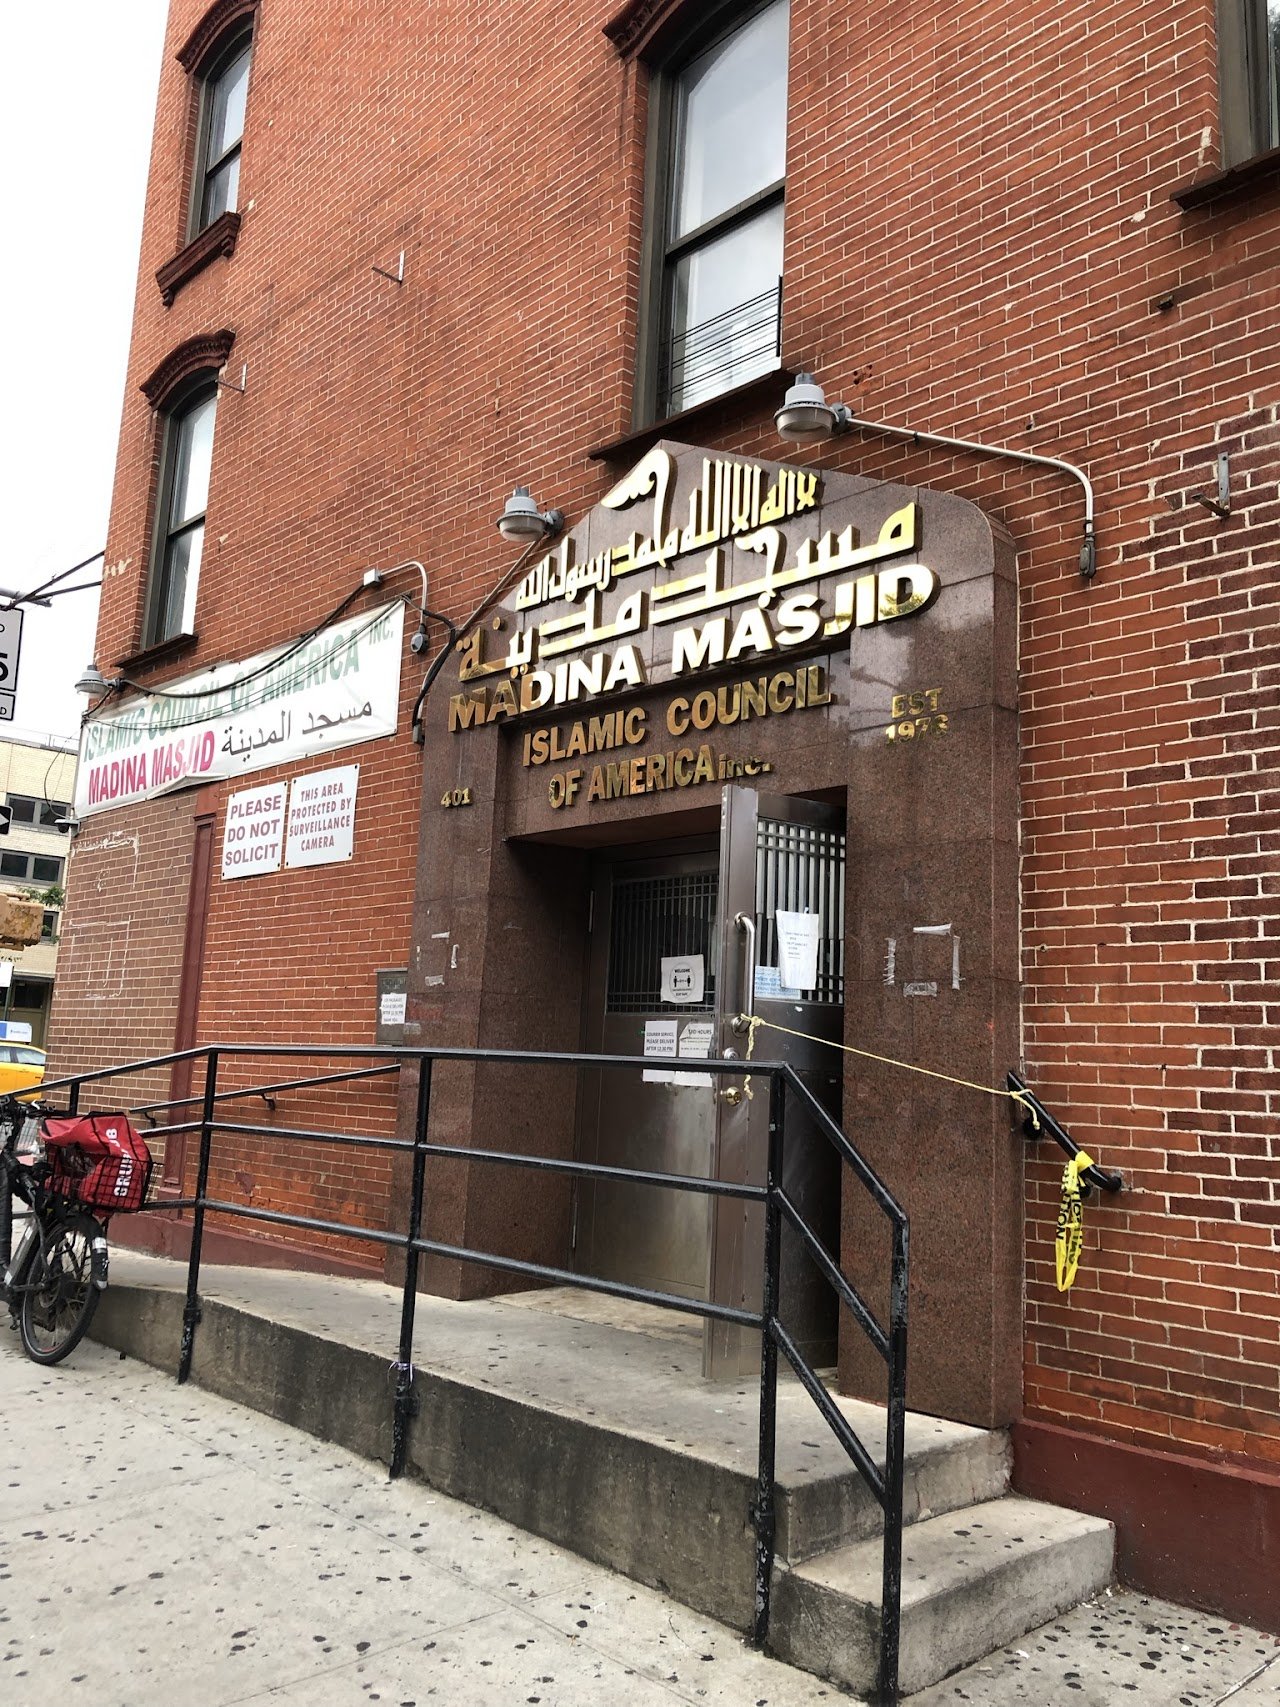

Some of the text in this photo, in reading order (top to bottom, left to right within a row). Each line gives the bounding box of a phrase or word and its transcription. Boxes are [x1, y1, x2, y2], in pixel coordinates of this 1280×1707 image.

[448, 562, 938, 734] MADINA MASJID
[83, 708, 146, 763] ISLAMIC
[148, 681, 223, 738] COUNCIL
[231, 667, 257, 714] OF
[260, 630, 360, 705] AMERICA
[892, 687, 943, 718] EST
[522, 665, 833, 768] ISLAMIC COUNCIL
[221, 700, 373, 763] مسجد المدينة
[88, 730, 216, 806] MADINA MASJID
[548, 769, 582, 809] OF
[587, 744, 715, 802] AMERICA
[301, 782, 344, 802] THIS AREA
[441, 786, 472, 808] 401
[230, 795, 282, 819] PLEASE
[291, 797, 352, 820] PROTECTED BY
[227, 819, 280, 843] DO NOT
[289, 815, 351, 837] SURVEILLANCE
[225, 843, 279, 866] SOLICIT
[301, 835, 335, 851] CAMERA
